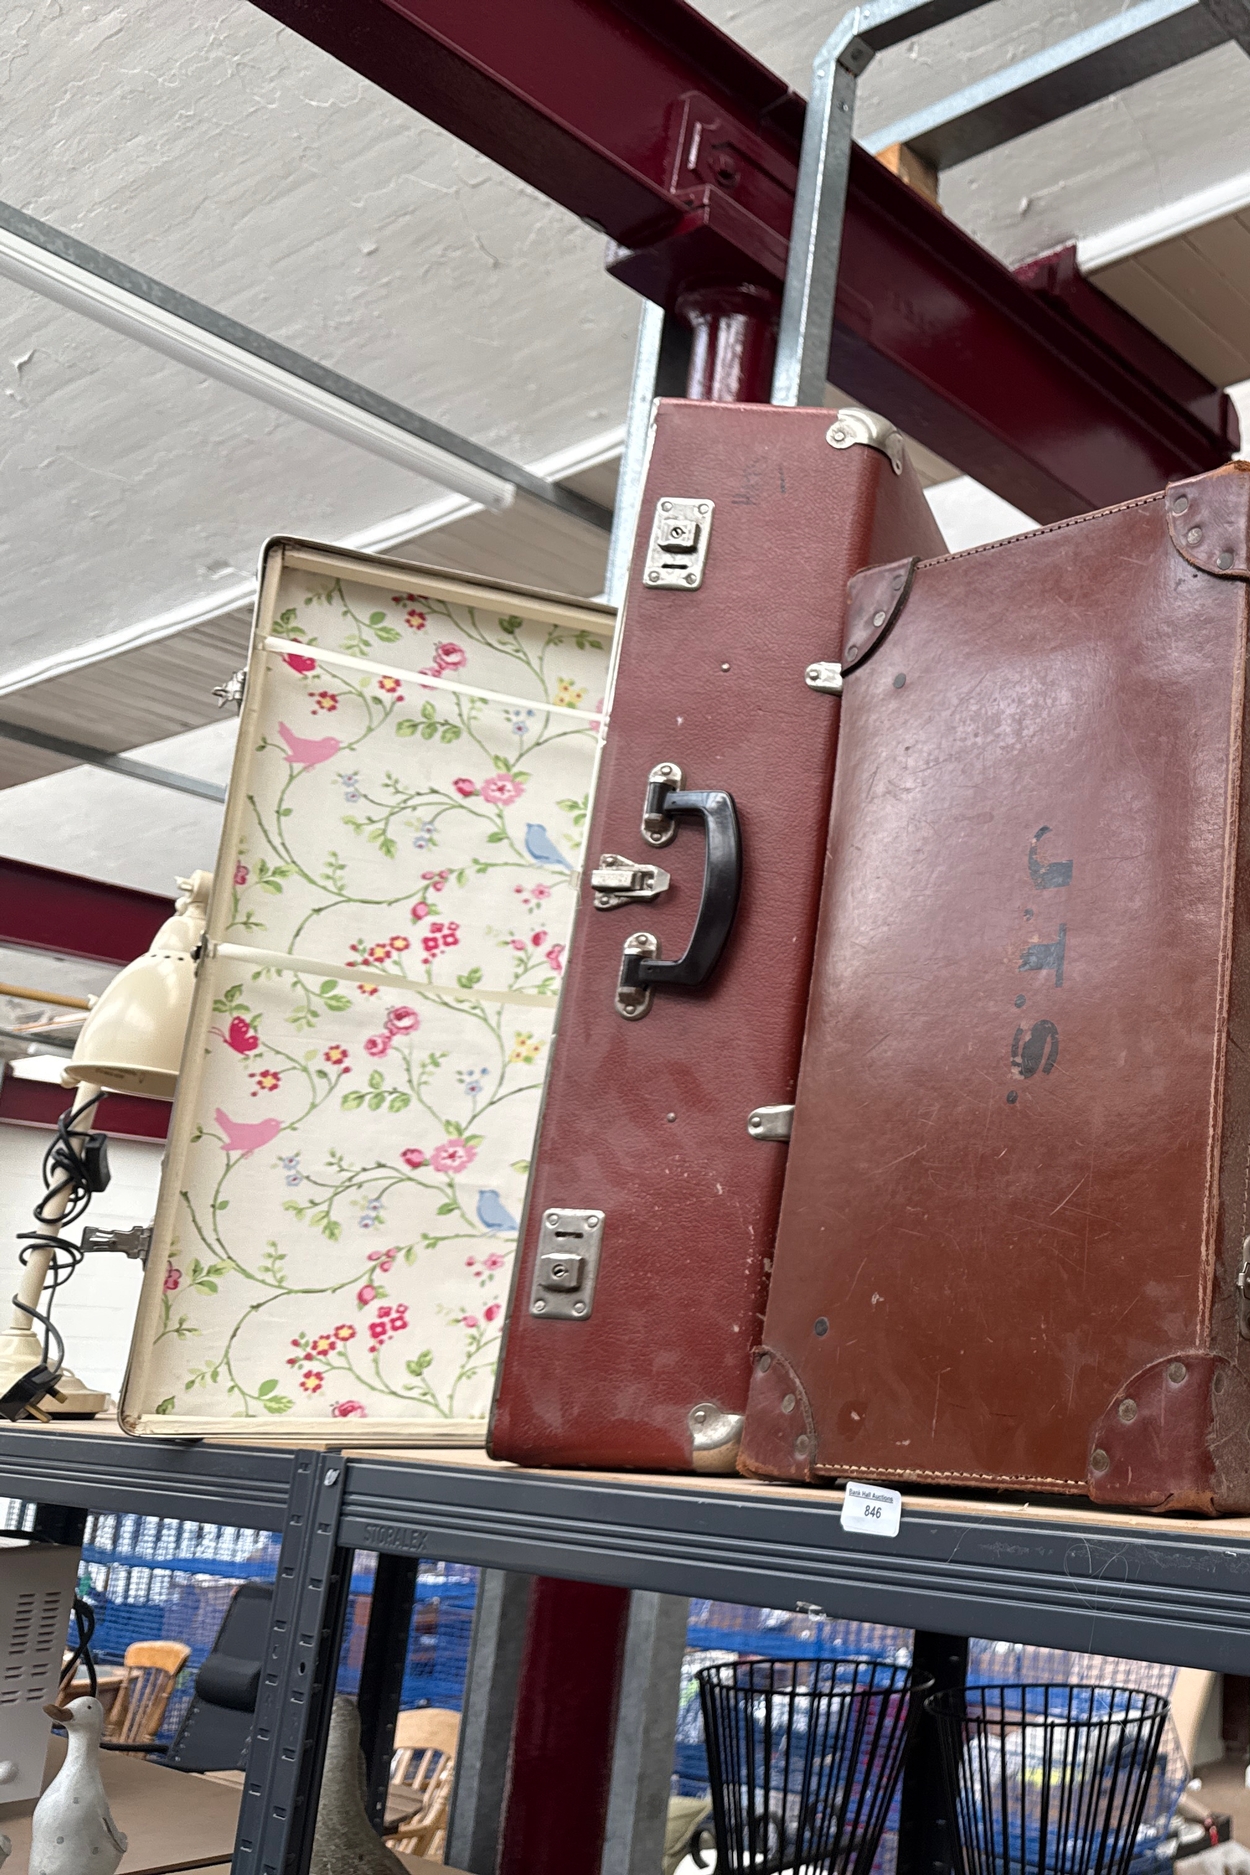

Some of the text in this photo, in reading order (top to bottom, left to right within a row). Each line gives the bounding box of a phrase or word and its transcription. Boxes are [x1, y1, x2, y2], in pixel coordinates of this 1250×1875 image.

[849, 1488, 894, 1502] Bank Hall Auctions
[864, 1505, 882, 1519] 846
